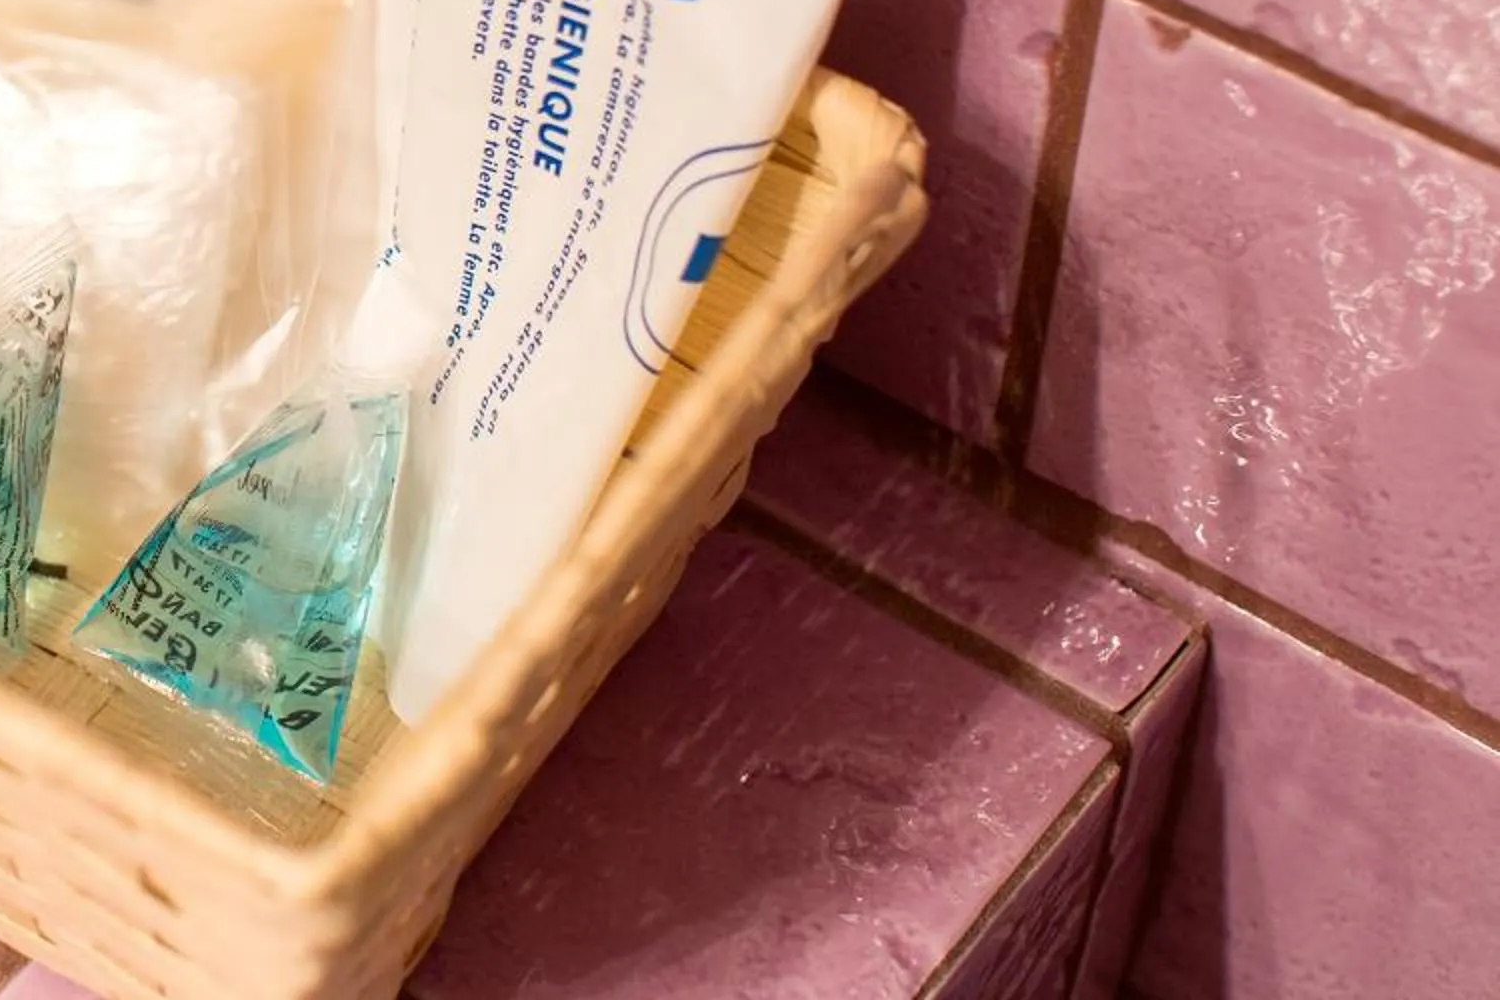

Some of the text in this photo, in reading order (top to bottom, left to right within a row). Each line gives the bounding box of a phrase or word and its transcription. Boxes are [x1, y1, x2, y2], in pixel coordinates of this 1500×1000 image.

[617, 33, 634, 60] La
[491, 58, 513, 107] dans
[515, 32, 545, 109] bandes
[487, 111, 507, 133] la
[591, 67, 624, 171] camarera
[473, 139, 500, 214] toilette.
[581, 175, 595, 201] se
[586, 198, 604, 232] etc.
[468, 222, 487, 245] La
[487, 240, 503, 275] etc.
[456, 251, 483, 317] femme
[446, 323, 463, 349] de
[516, 320, 533, 347] de
